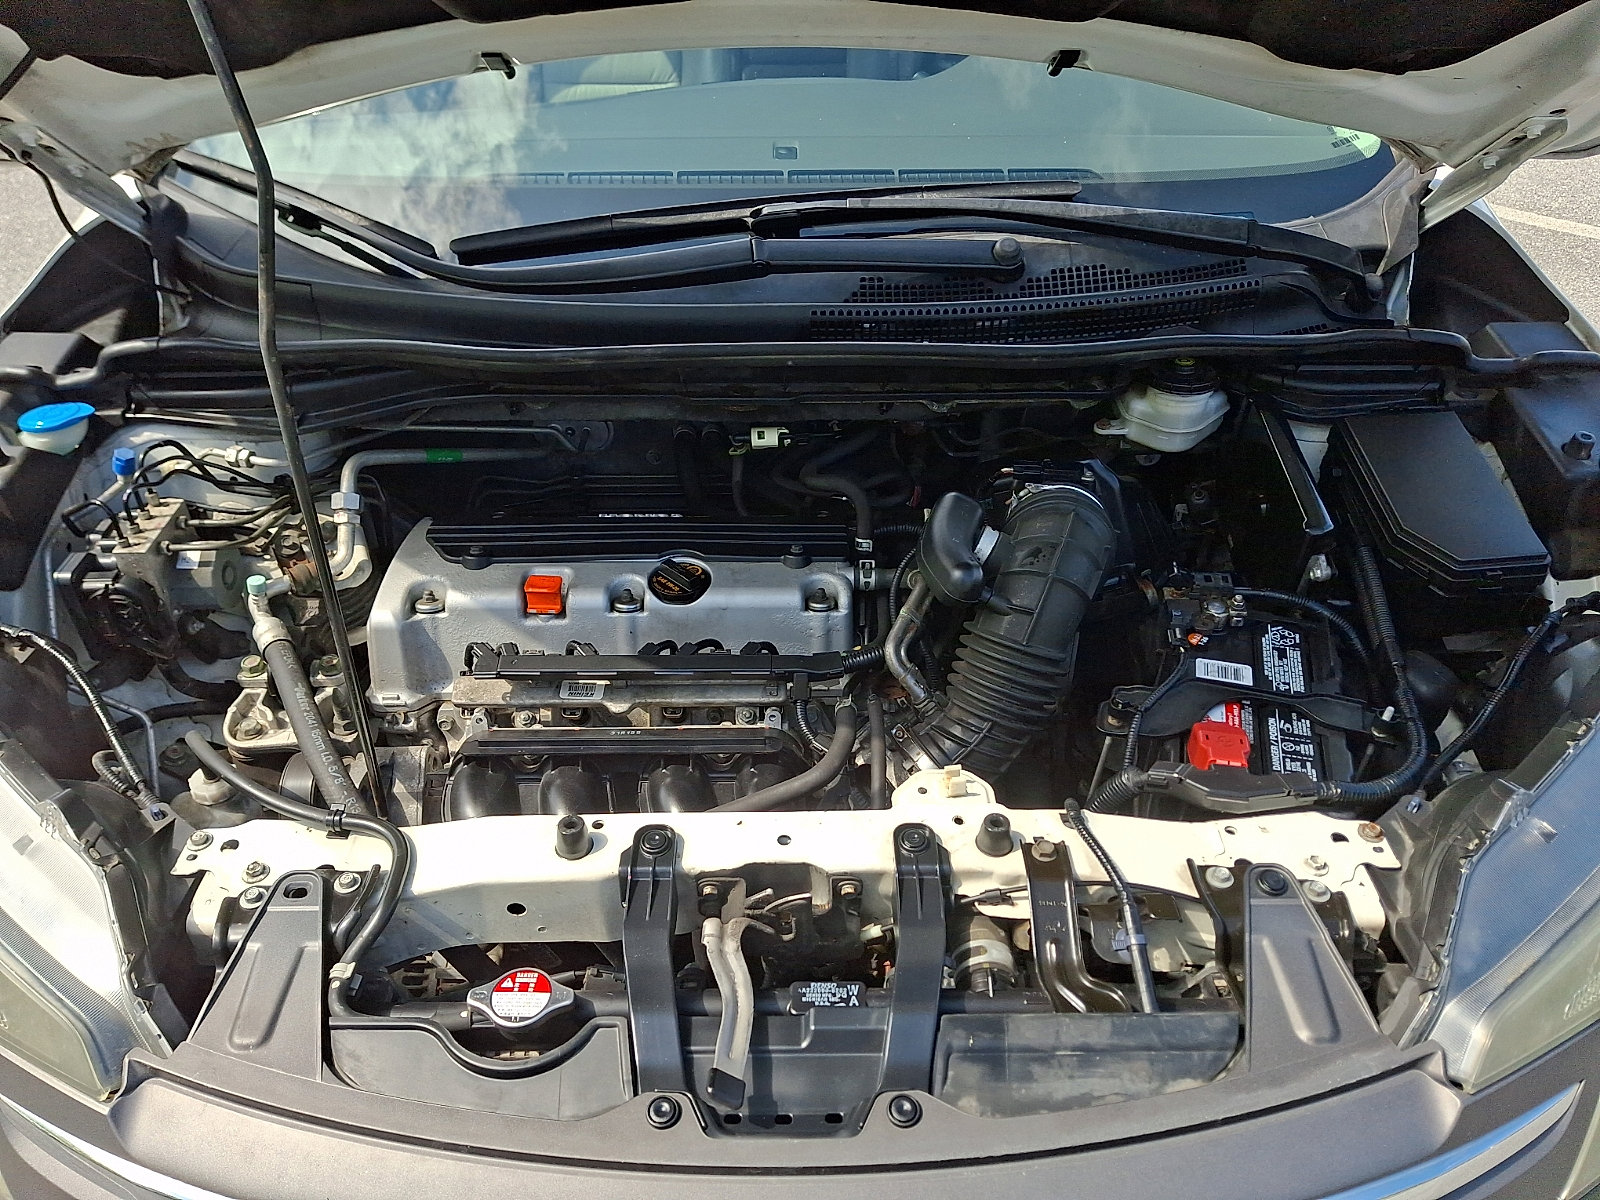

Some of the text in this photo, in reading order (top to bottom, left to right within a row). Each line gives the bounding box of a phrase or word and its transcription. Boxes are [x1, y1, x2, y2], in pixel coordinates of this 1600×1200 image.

[312, 729, 325, 751] 16mm
[1268, 717, 1278, 741] POISON
[1270, 745, 1281, 771] DANGER
[847, 984, 860, 996] W
[848, 995, 860, 1007] A
